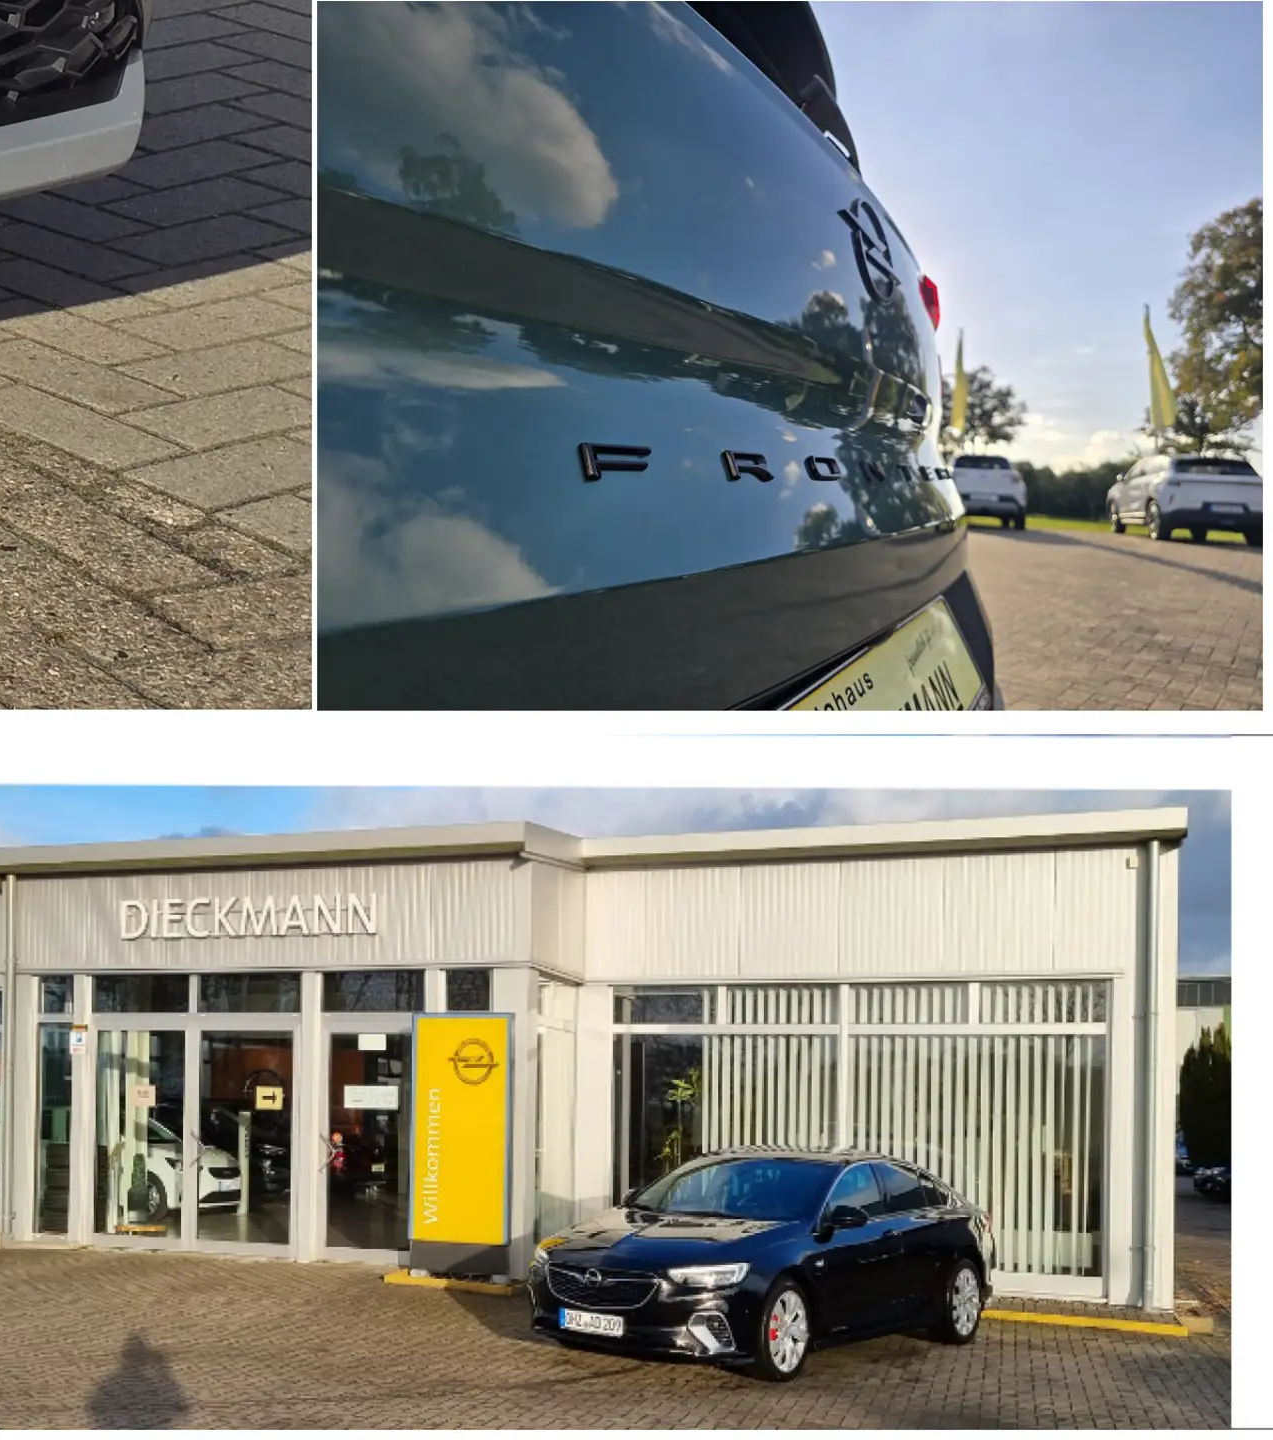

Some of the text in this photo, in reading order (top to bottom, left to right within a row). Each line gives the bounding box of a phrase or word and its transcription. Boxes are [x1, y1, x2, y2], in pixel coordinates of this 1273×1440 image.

[816, 672, 874, 711] ohaus
[120, 893, 377, 941] DIECKMANN
[422, 1087, 441, 1224] Willkommen
